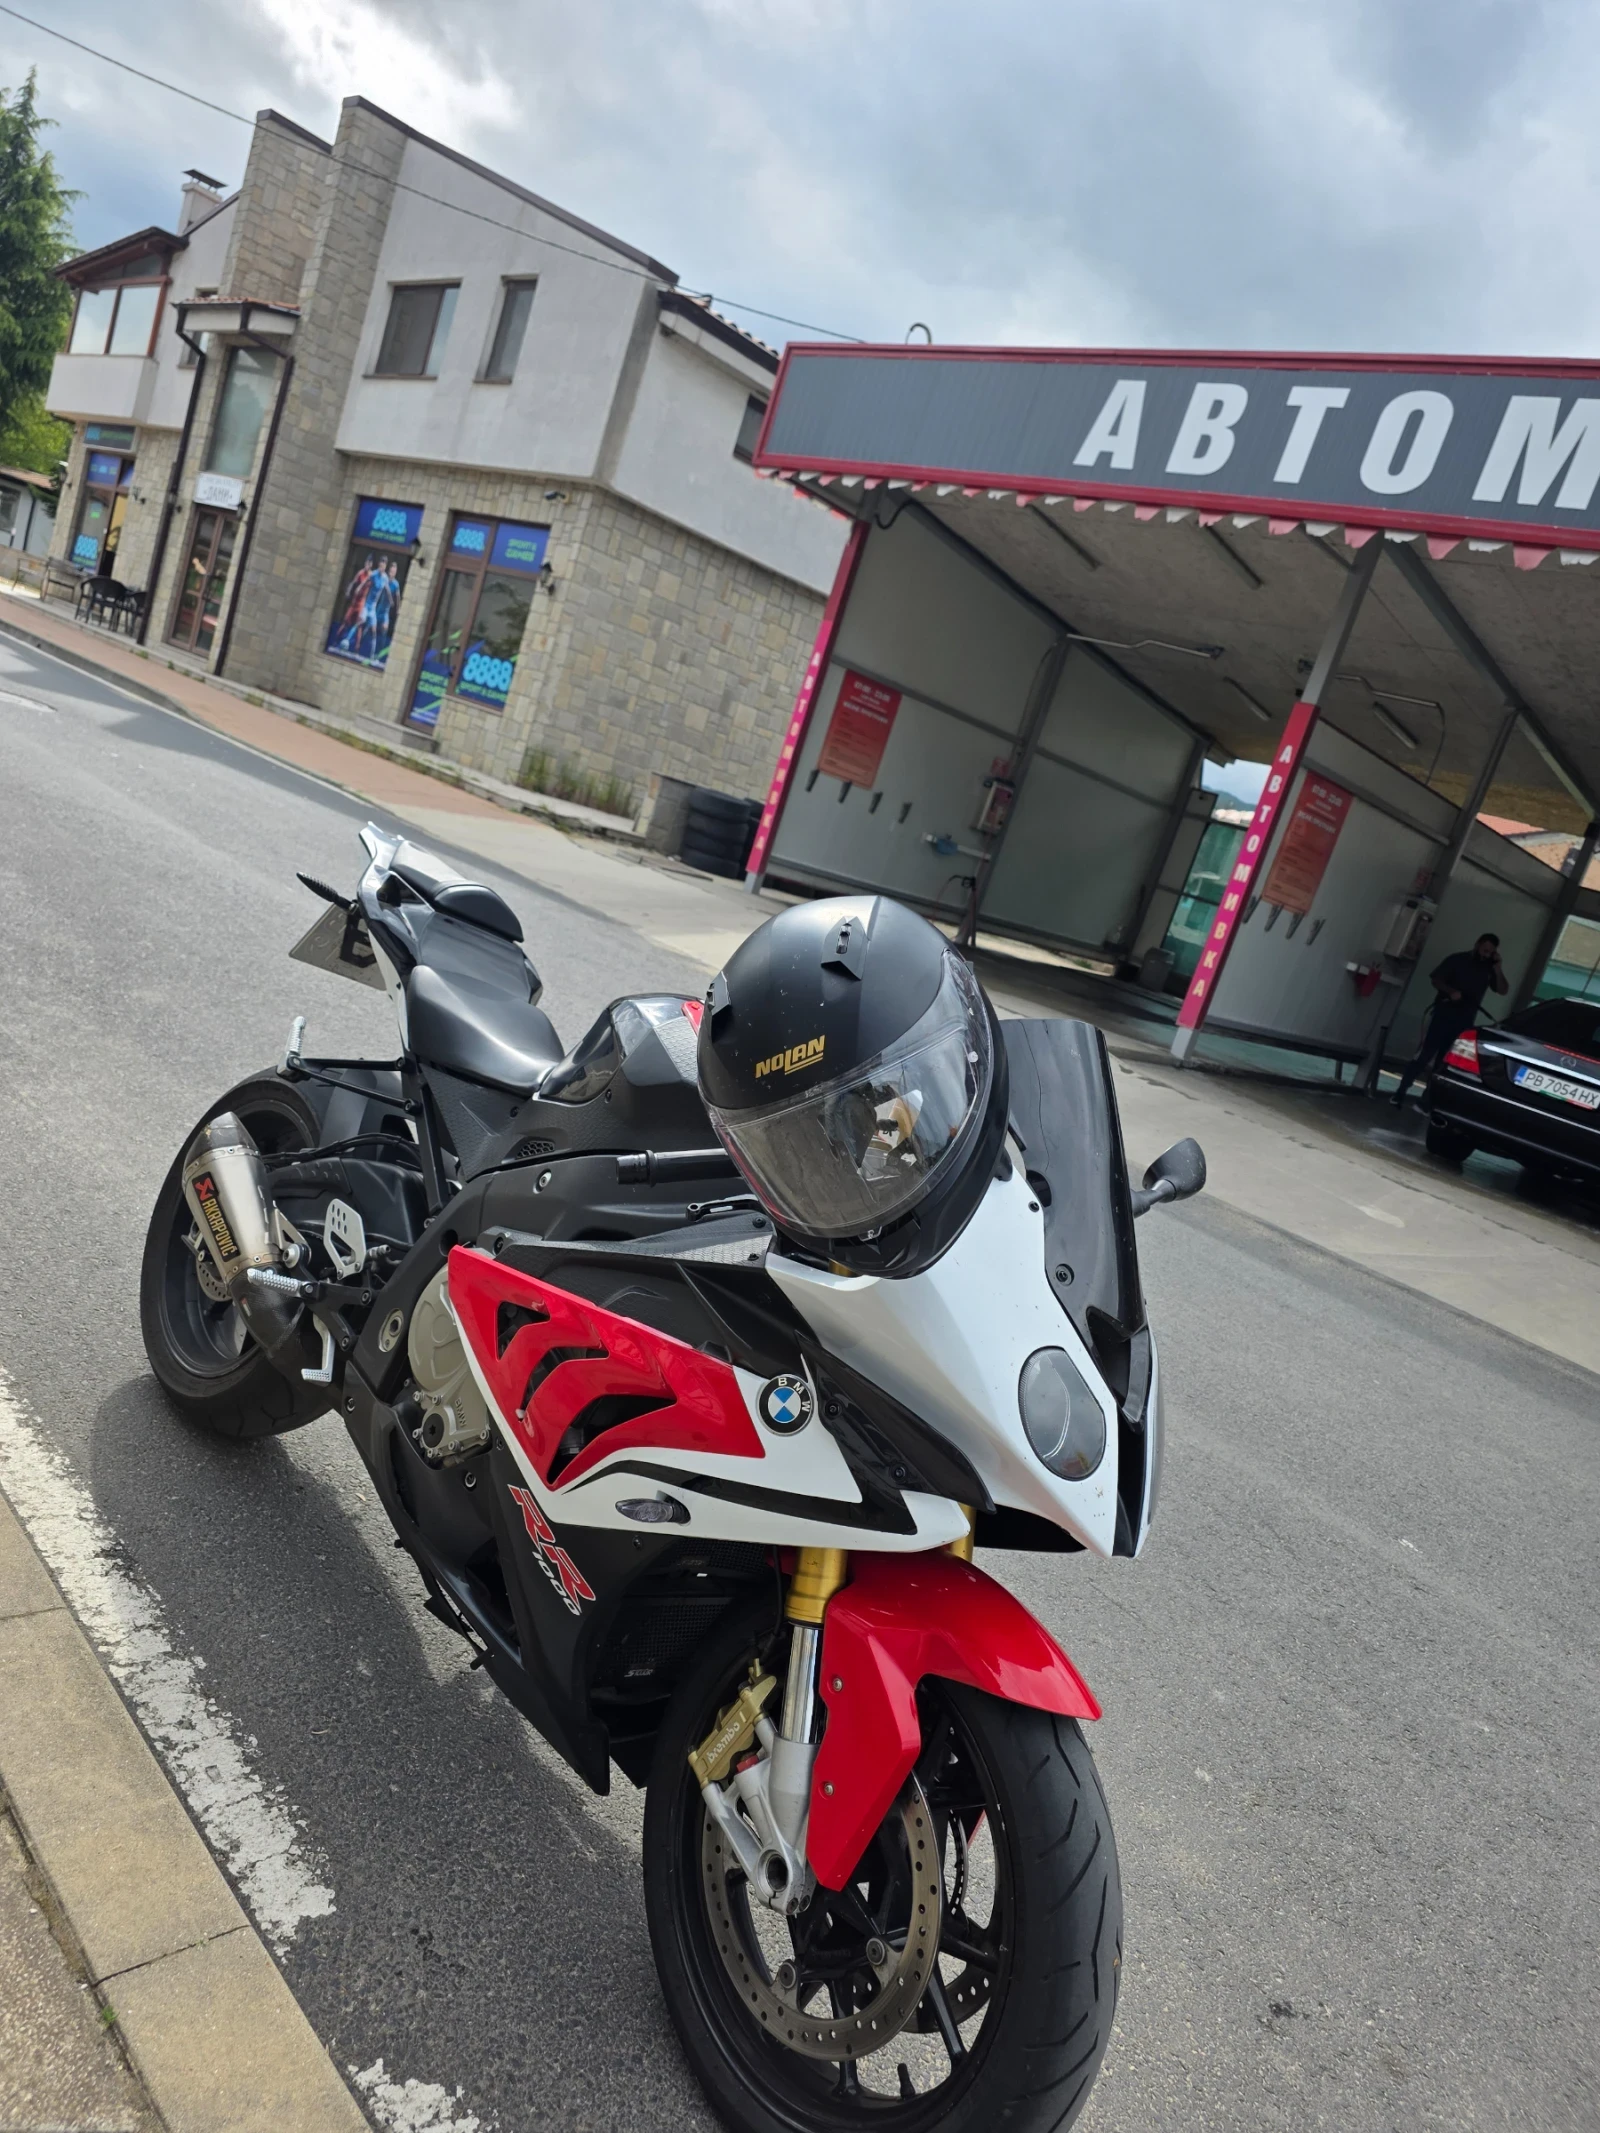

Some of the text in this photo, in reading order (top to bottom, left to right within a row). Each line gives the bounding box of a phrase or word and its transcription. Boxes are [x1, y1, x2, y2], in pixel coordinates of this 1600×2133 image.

[1072, 378, 1600, 511] АВТОМ
[462, 652, 513, 692] 8888
[1192, 745, 1293, 997] АВТОМИВКА
[755, 1034, 826, 1079] NOLAN
[1544, 1078, 1578, 1099] 7054
[777, 1377, 811, 1413] BMW
[507, 1484, 597, 1614] RR
[532, 1551, 580, 1616] 1000
[706, 1722, 740, 1764] brembo
